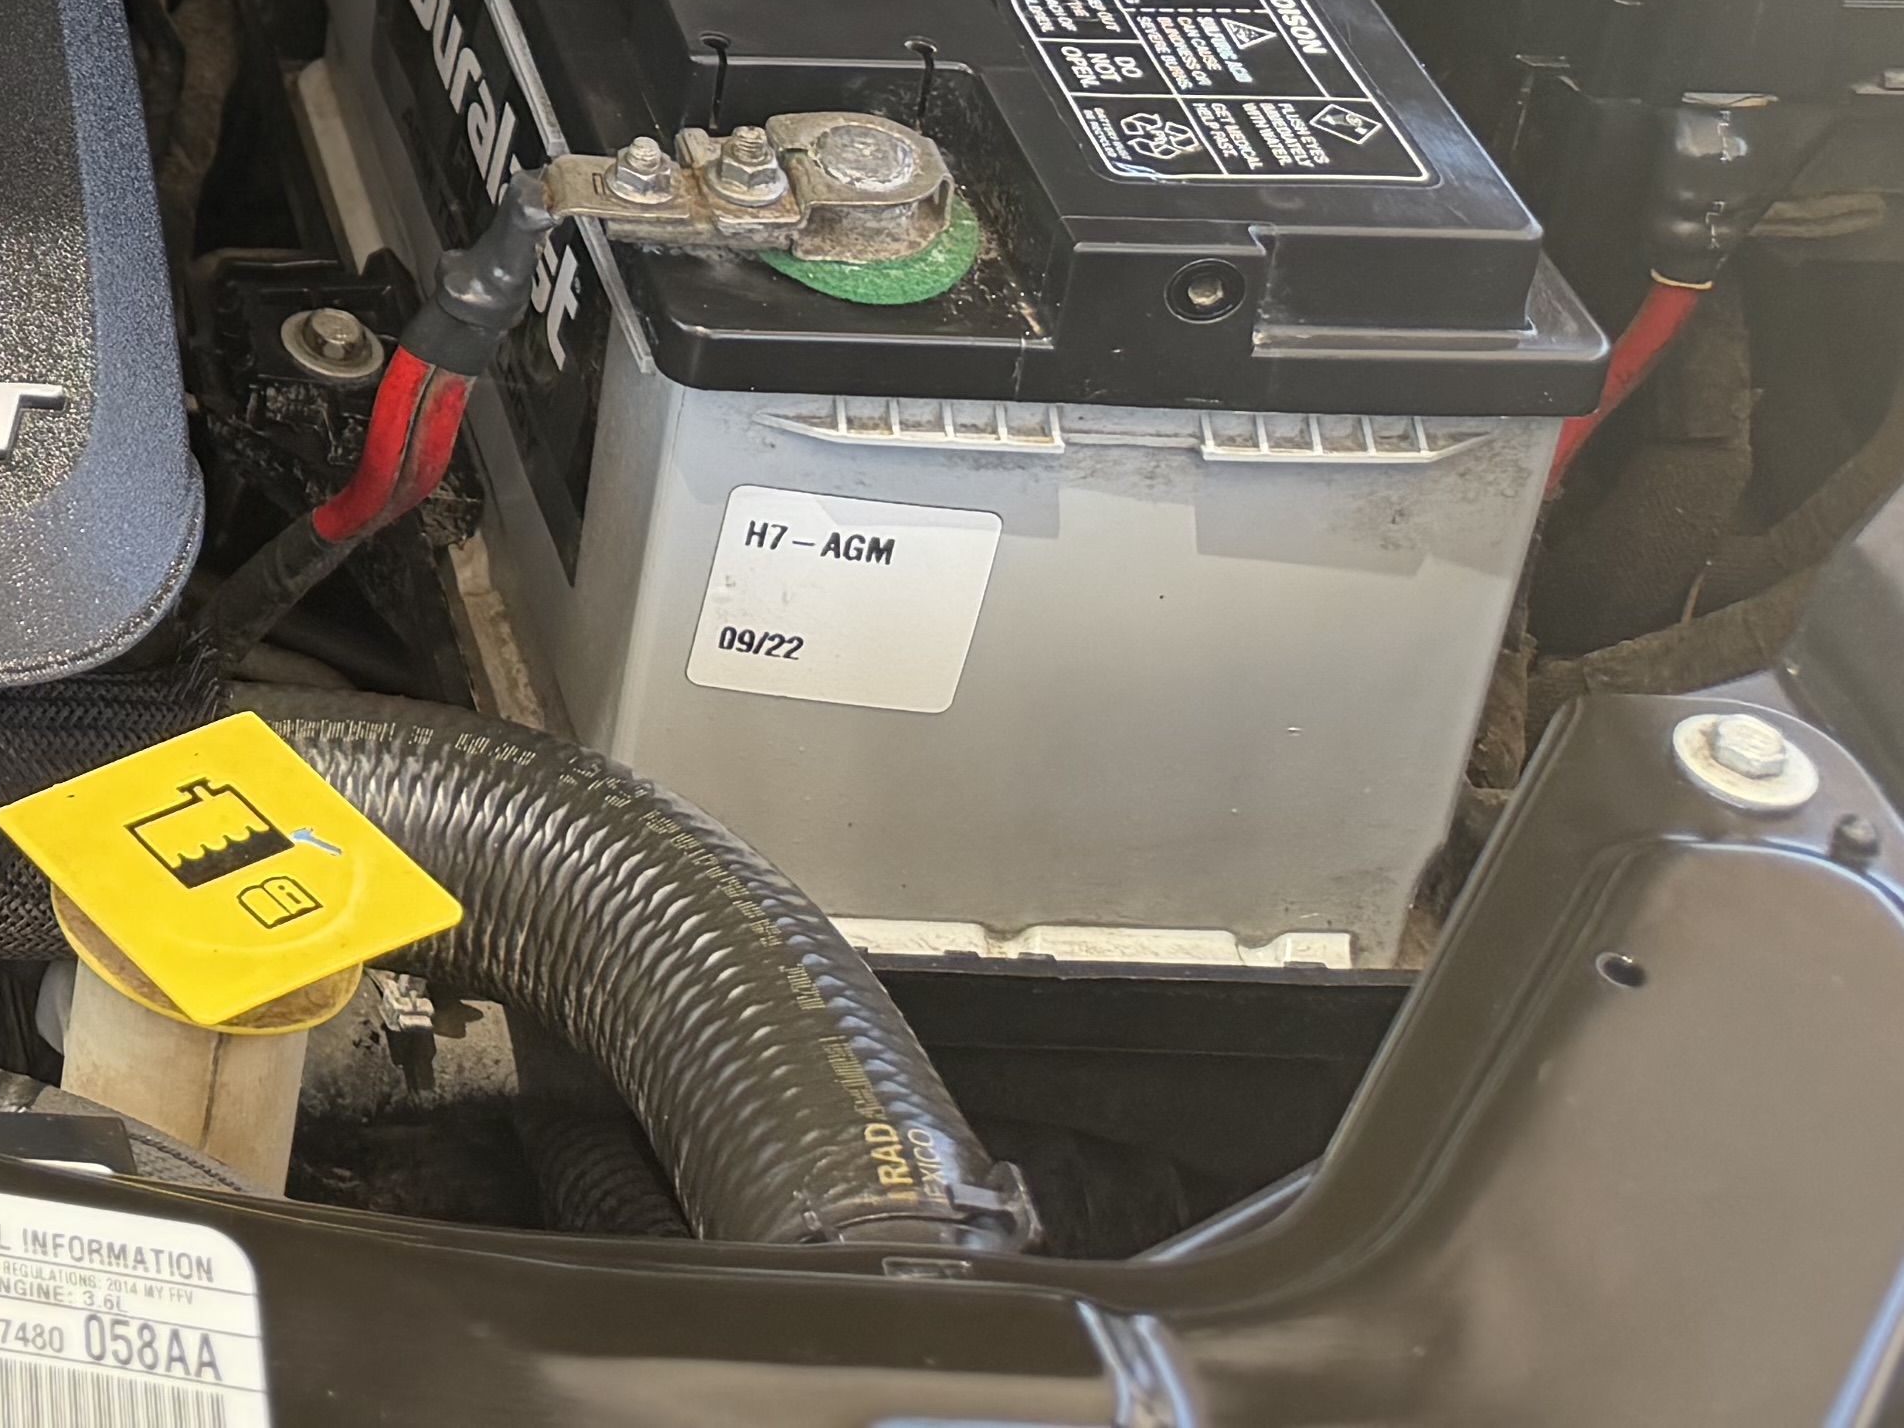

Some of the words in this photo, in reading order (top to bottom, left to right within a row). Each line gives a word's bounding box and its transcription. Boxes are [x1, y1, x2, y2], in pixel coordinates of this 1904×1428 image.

[1088, 53, 1122, 82] NOT
[1114, 57, 1142, 77] DO
[1190, 102, 1219, 128] HELP
[1241, 103, 1269, 126] WITH
[1278, 103, 1308, 134] FLUSH
[1208, 102, 1233, 122] GET
[1223, 124, 1263, 169] MEDICAL
[745, 520, 895, 565] H7-AGM
[718, 626, 804, 660] 09/22
[864, 1123, 914, 1186] RAD
[22, 1228, 214, 1282] INFORMATION
[4, 1261, 102, 1290] REGULATIONS:
[106, 1278, 138, 1296] 2014
[83, 1290, 129, 1313] 3.6L
[85, 1313, 223, 1382] 058AA
